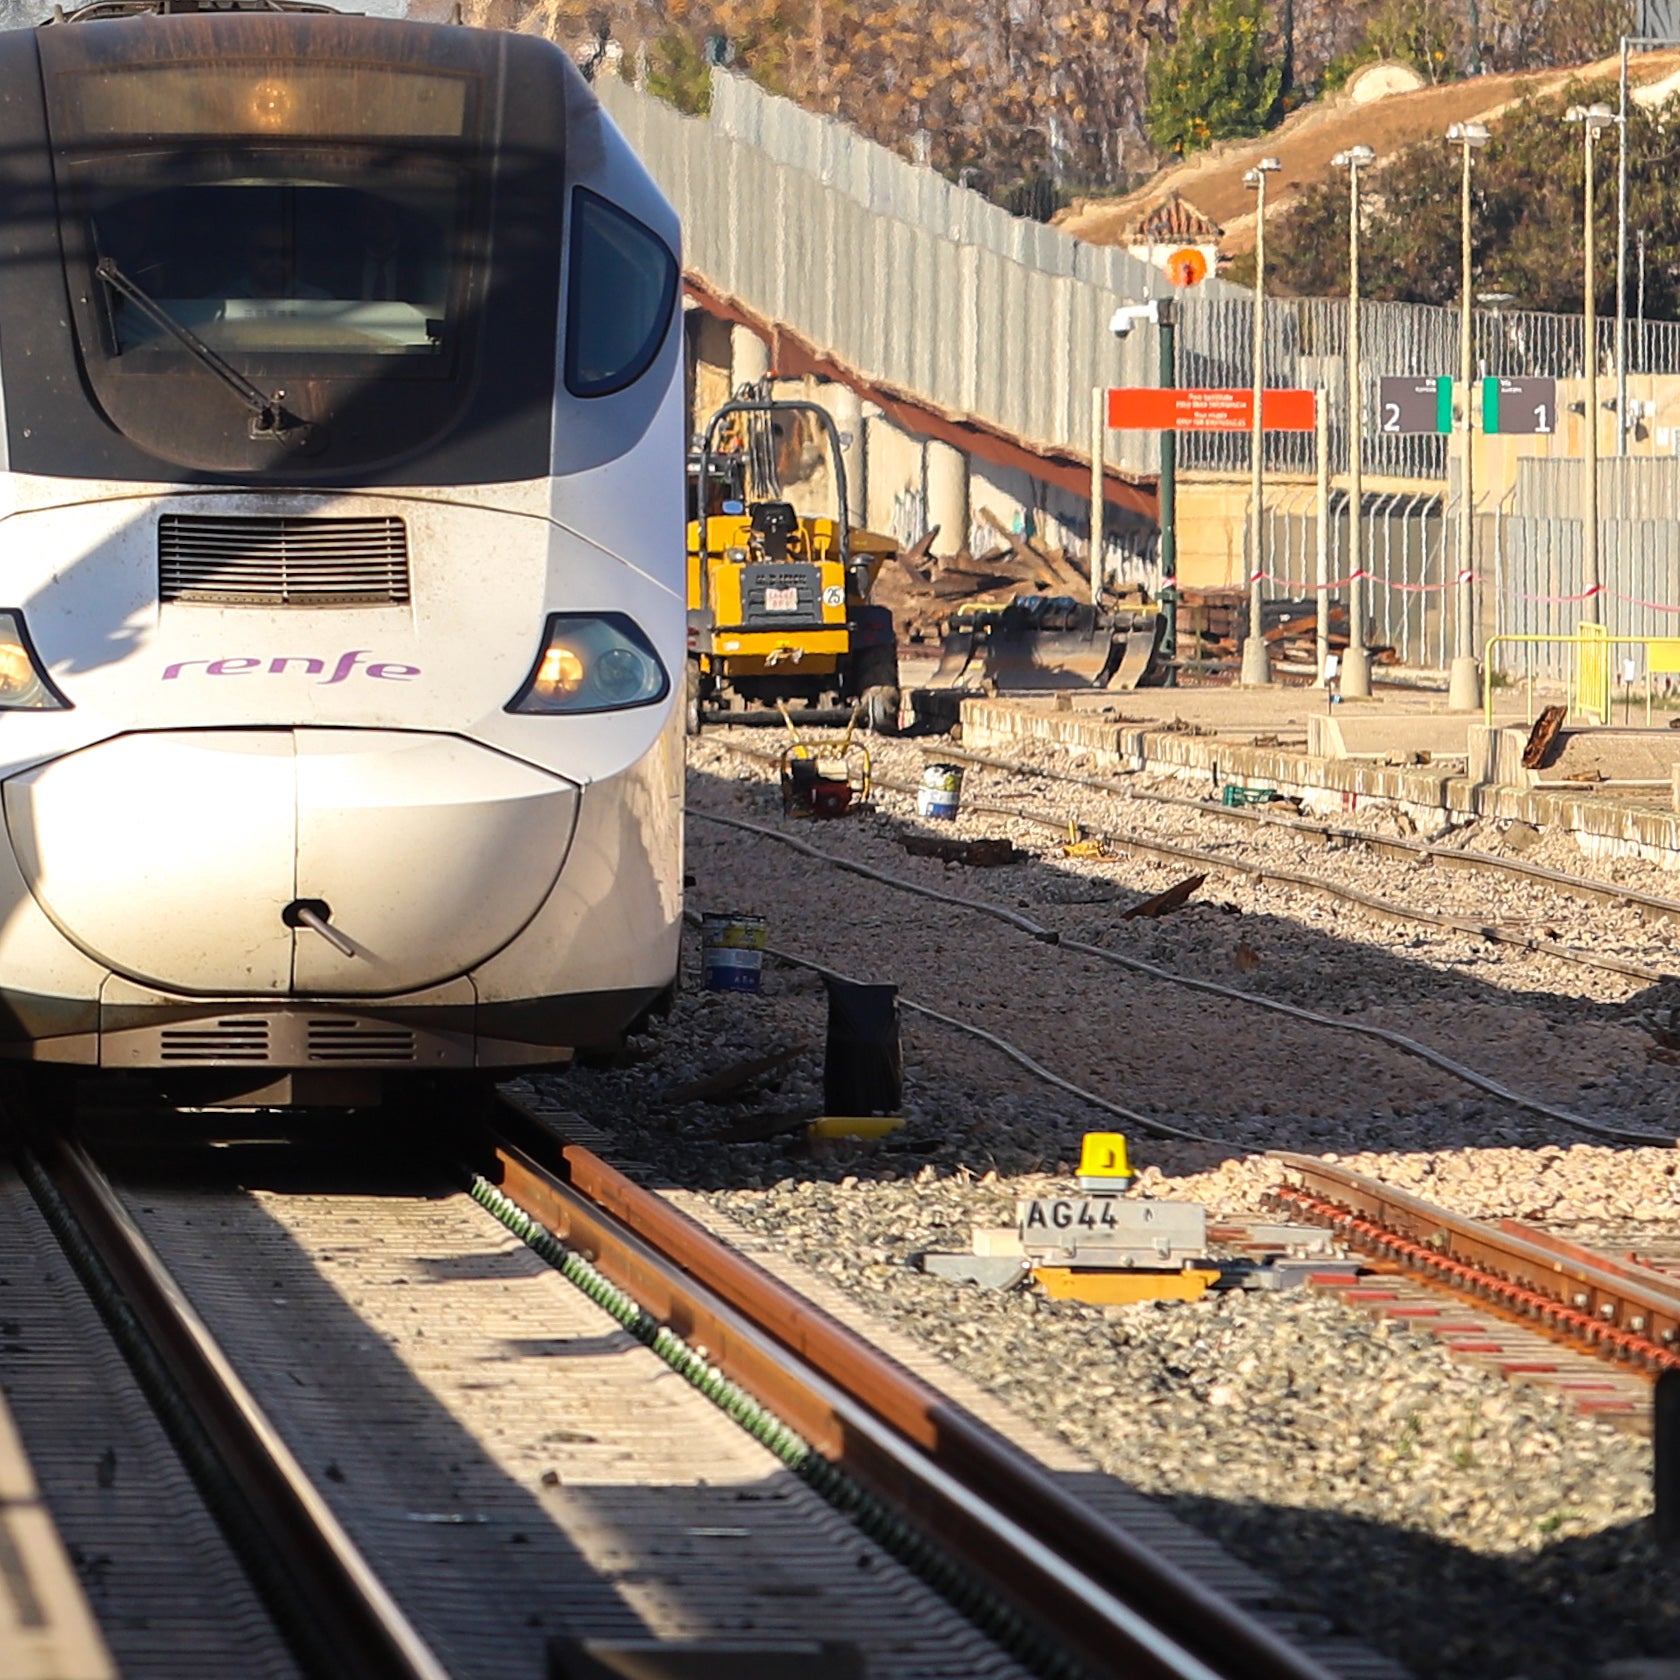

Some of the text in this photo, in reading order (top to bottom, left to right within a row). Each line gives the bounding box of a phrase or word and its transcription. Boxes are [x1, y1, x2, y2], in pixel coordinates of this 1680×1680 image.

[1383, 403, 1400, 432] 2
[1533, 404, 1551, 432] 1
[827, 587, 841, 604] 25
[161, 649, 424, 685] renfe
[1026, 1200, 1119, 1231] AG44
